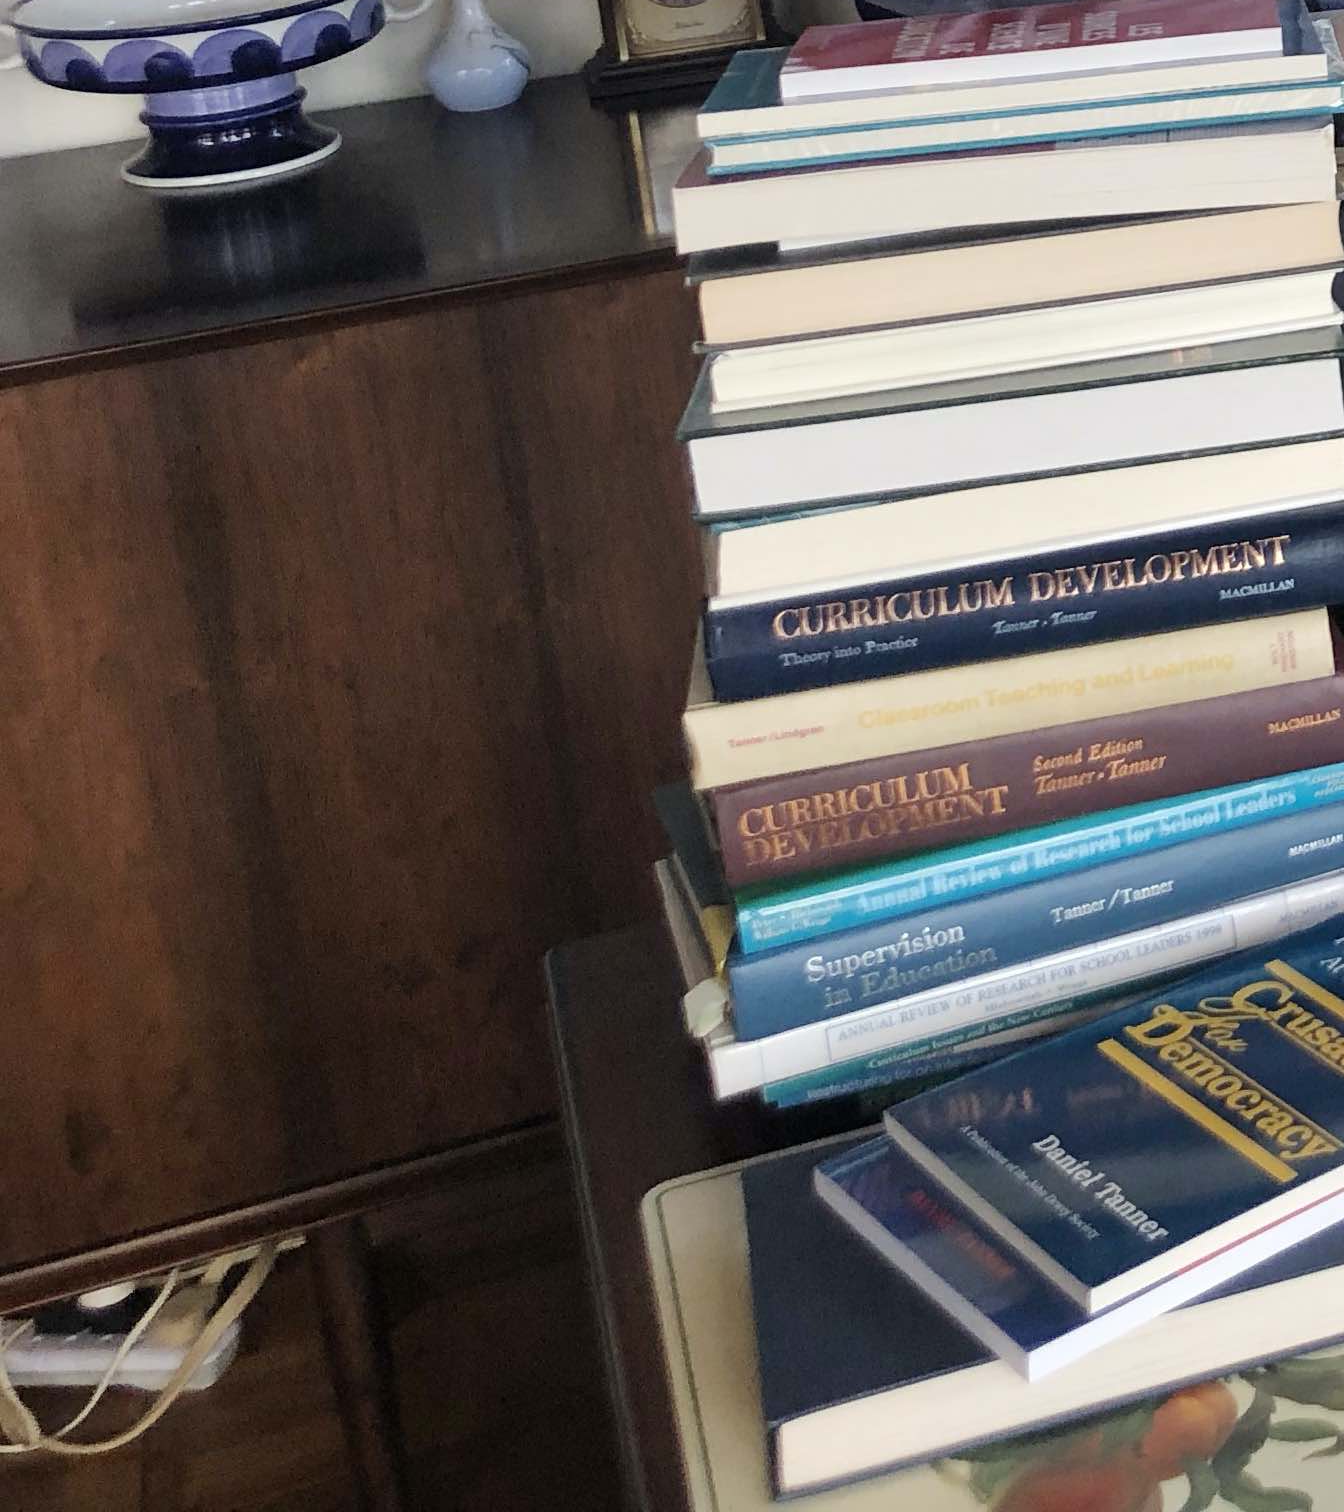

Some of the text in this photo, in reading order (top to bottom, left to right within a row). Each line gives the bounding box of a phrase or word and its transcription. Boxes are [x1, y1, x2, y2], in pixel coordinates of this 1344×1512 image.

[773, 535, 1290, 639] CURRICULUM DEVELOPMENT
[1219, 578, 1295, 600] MACMILLAN
[780, 636, 919, 668] Theory into Practice
[992, 609, 1098, 635] Tanner Tanner
[858, 654, 1234, 728] Classroom Teaching and Learning
[1268, 707, 1341, 735] MACMILLAN
[1033, 737, 1144, 773] Second Edition
[1034, 754, 1168, 795] Tanner Tanner
[738, 763, 973, 837] CURRICULUM
[744, 785, 1008, 866] DEVELOPMENT
[857, 788, 1297, 914] Annual Review of Research for School Leaders
[1288, 834, 1344, 857] MACMILLAN
[805, 922, 966, 983] Supervision
[824, 985, 852, 1007] in
[860, 945, 998, 998] Education
[838, 1014, 897, 1041] ANNUAL
[900, 999, 951, 1024] REVIEW
[955, 993, 974, 1008] OF
[978, 974, 1047, 1002] RESEARCH
[1050, 964, 1077, 983] FOR
[1080, 949, 1132, 977] SCHOOL
[1136, 931, 1193, 959] LEADERS
[1124, 1004, 1342, 1160] Democracy
[1030, 1134, 1170, 1241] Daniel Tanner
